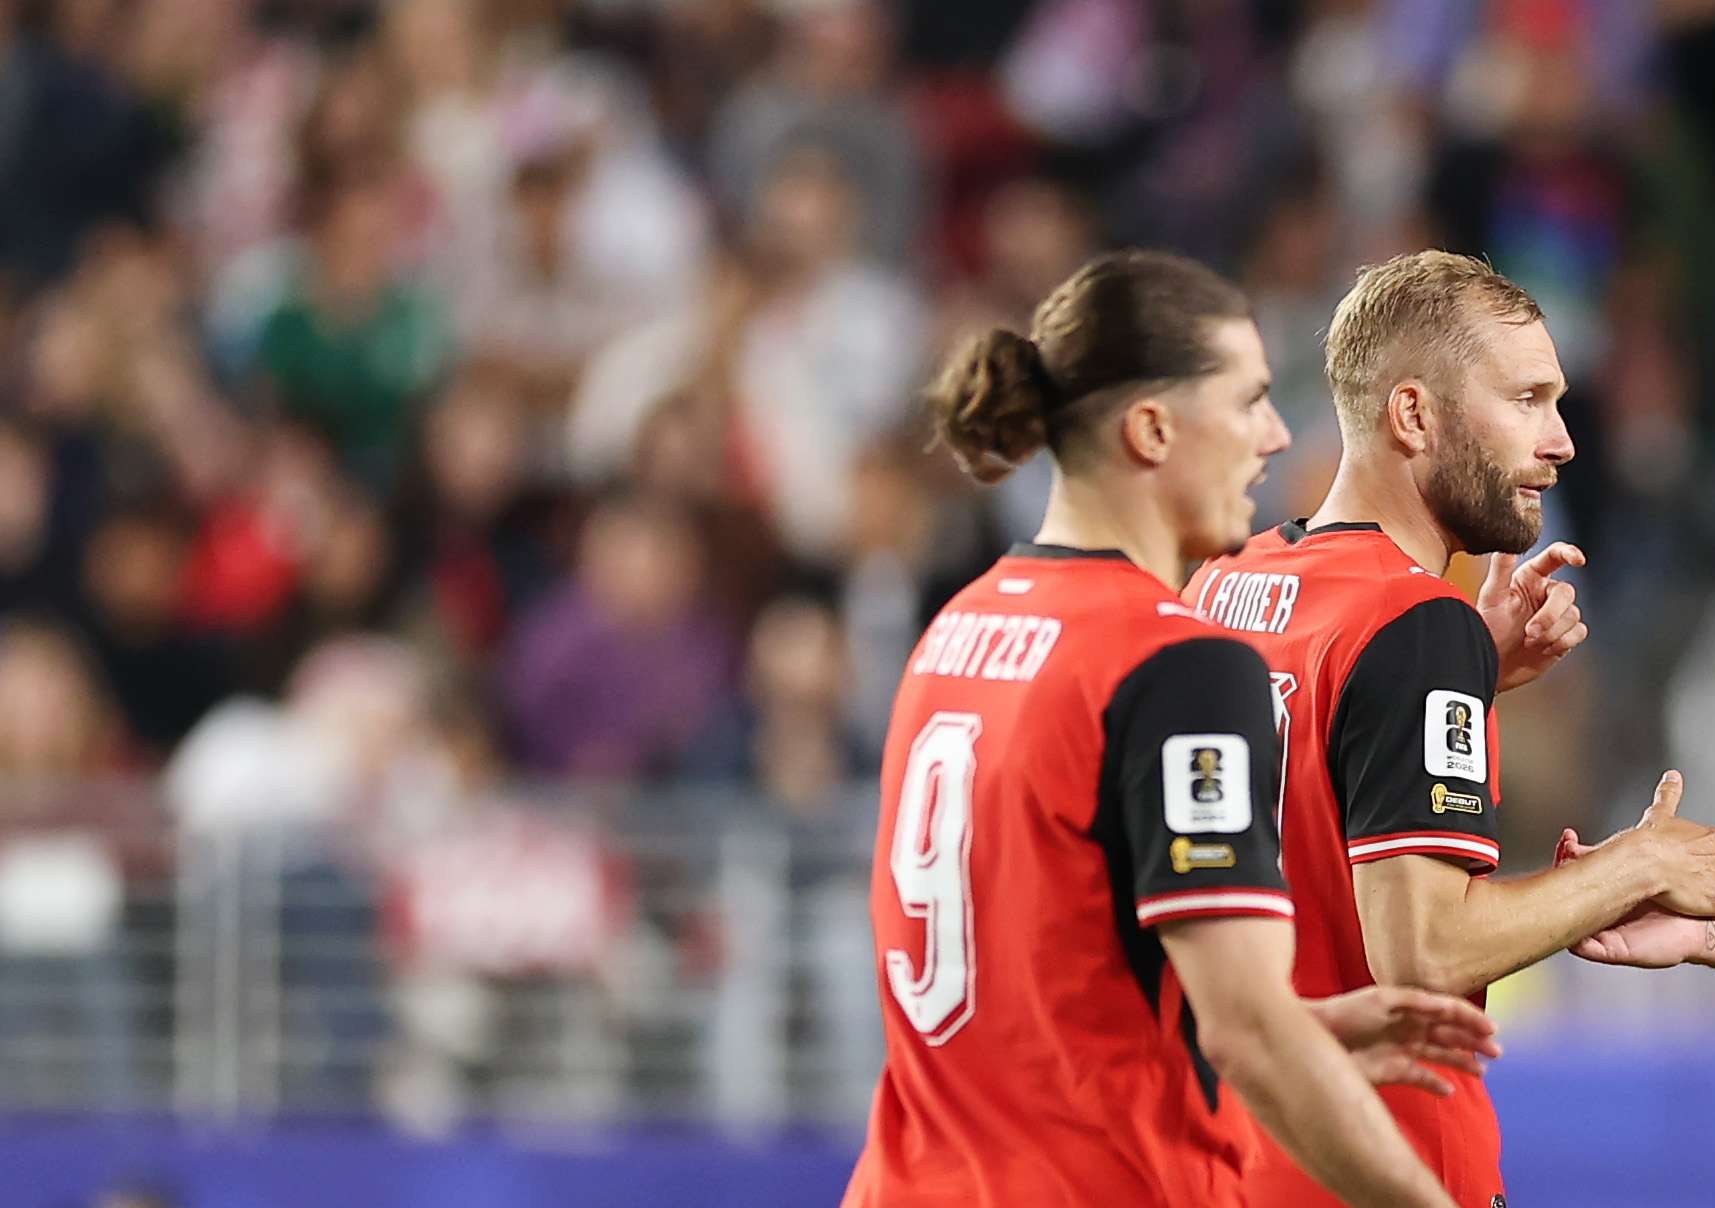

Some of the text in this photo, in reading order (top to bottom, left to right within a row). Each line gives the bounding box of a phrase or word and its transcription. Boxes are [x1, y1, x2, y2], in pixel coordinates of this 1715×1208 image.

[1193, 568, 1301, 634] LAIMER
[1445, 796, 1477, 807] DEBUT
[886, 711, 983, 1047] 9
